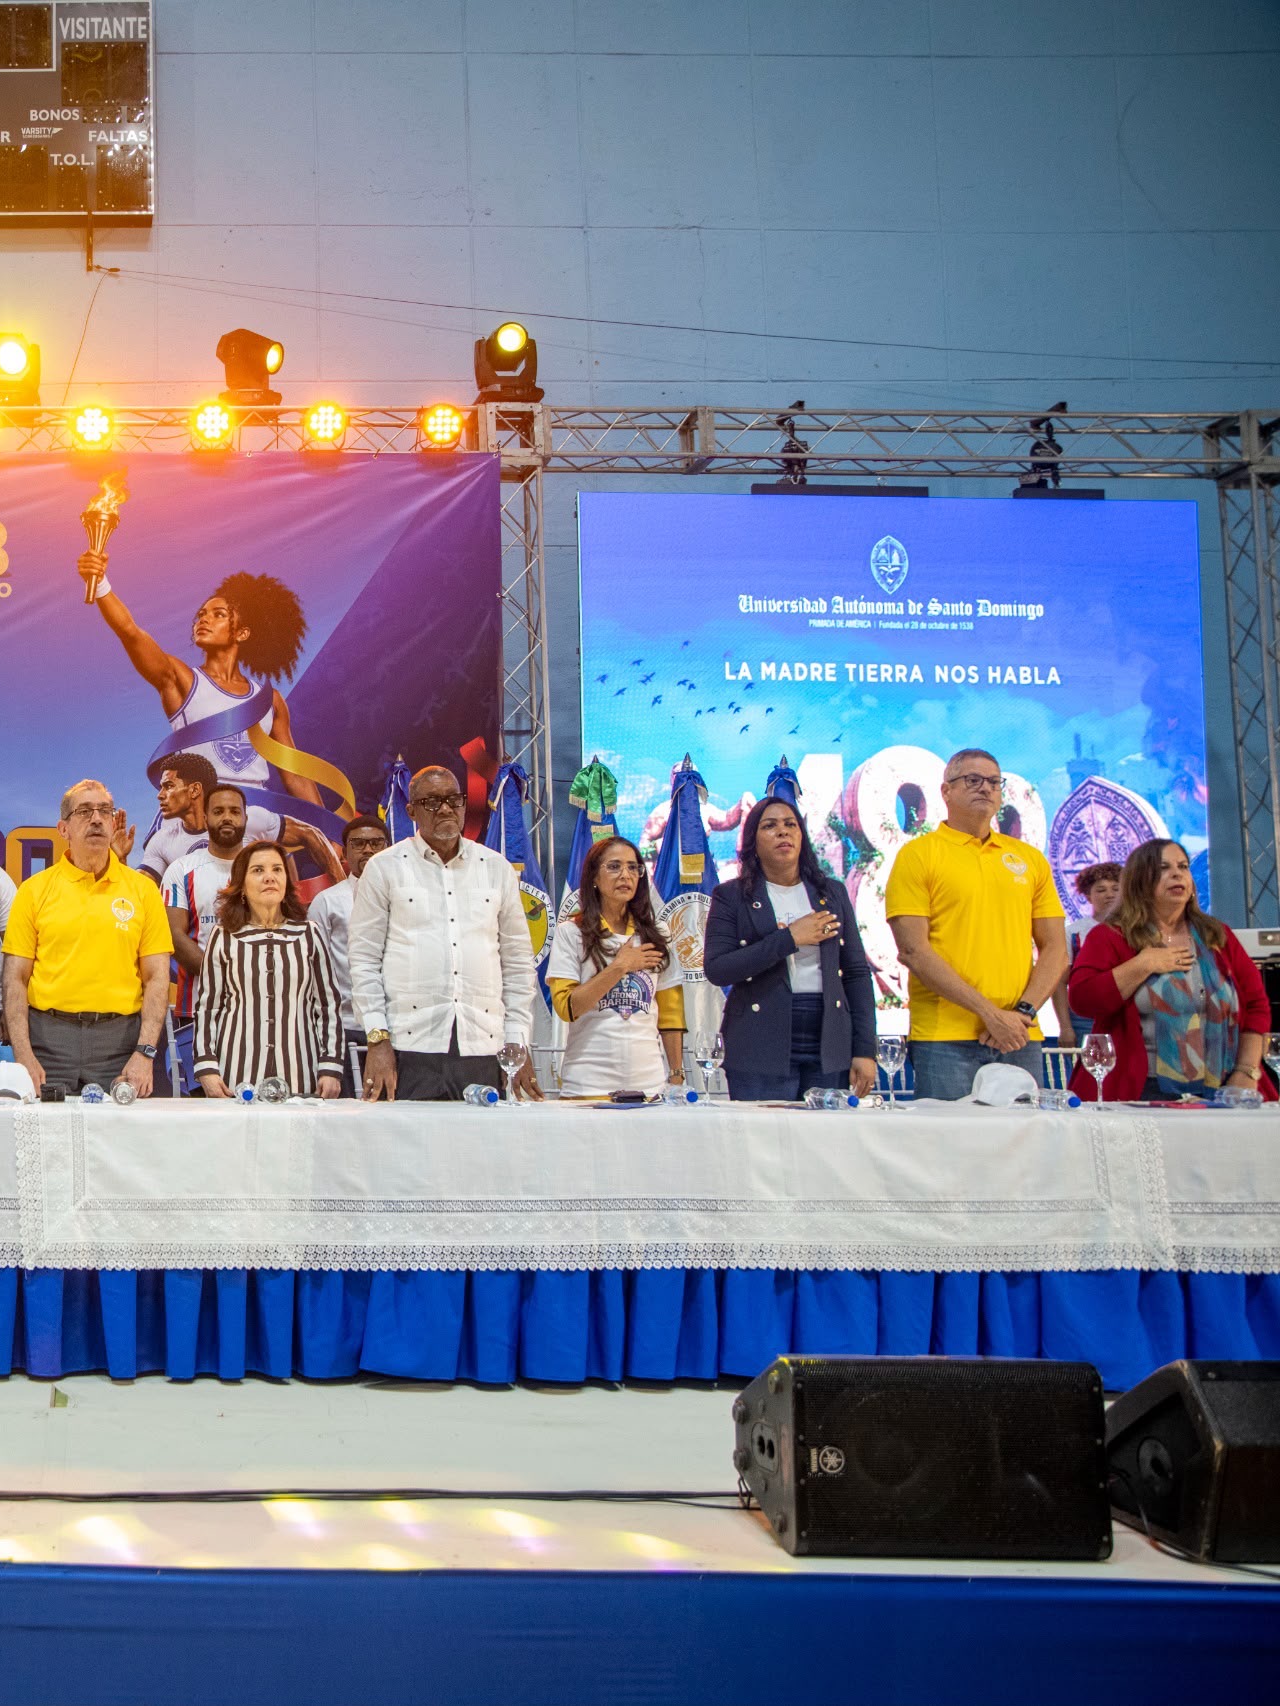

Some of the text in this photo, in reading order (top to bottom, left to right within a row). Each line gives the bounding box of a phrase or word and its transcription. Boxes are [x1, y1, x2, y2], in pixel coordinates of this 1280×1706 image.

[59, 17, 147, 39] VISITANTE
[30, 109, 80, 122] BONOS
[21, 127, 51, 135] VARSITY
[88, 130, 148, 143] FALTAS
[50, 153, 94, 166] T.O.L.
[738, 595, 1044, 620] Universidad Autónoma de Santo Domingo
[809, 619, 835, 628] PRIMADA
[879, 620, 903, 629] Fundada
[927, 621, 949, 630] octubre
[725, 662, 1061, 685] LA MADRE TIERRA NOS HABLA
